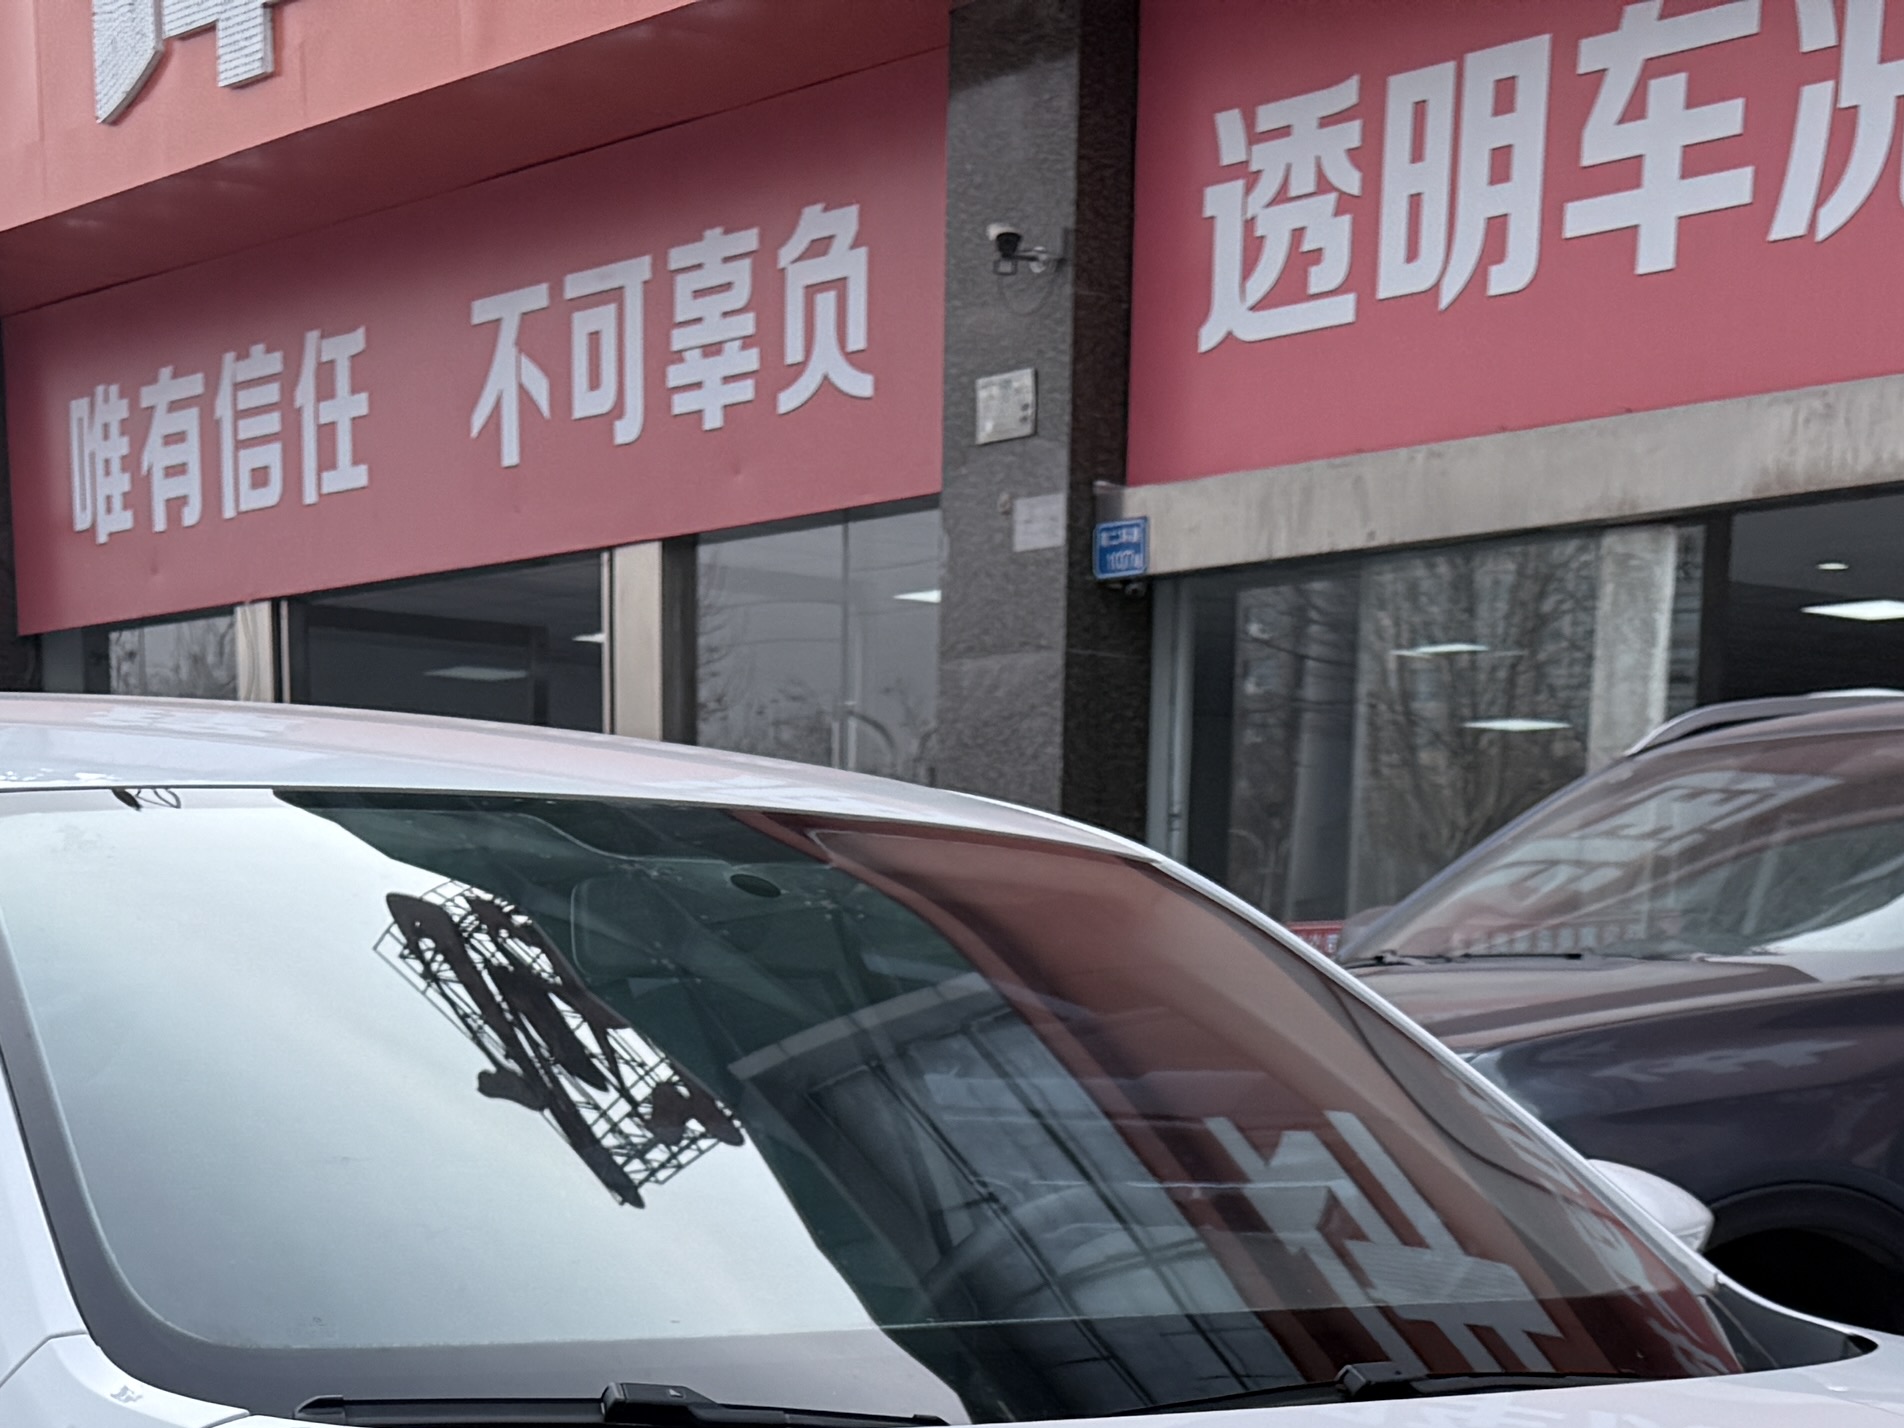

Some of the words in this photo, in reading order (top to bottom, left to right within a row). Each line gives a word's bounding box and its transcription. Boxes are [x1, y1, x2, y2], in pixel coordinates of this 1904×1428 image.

[68, 325, 369, 544] 唯有信任
[469, 202, 875, 468] 不可辜负
